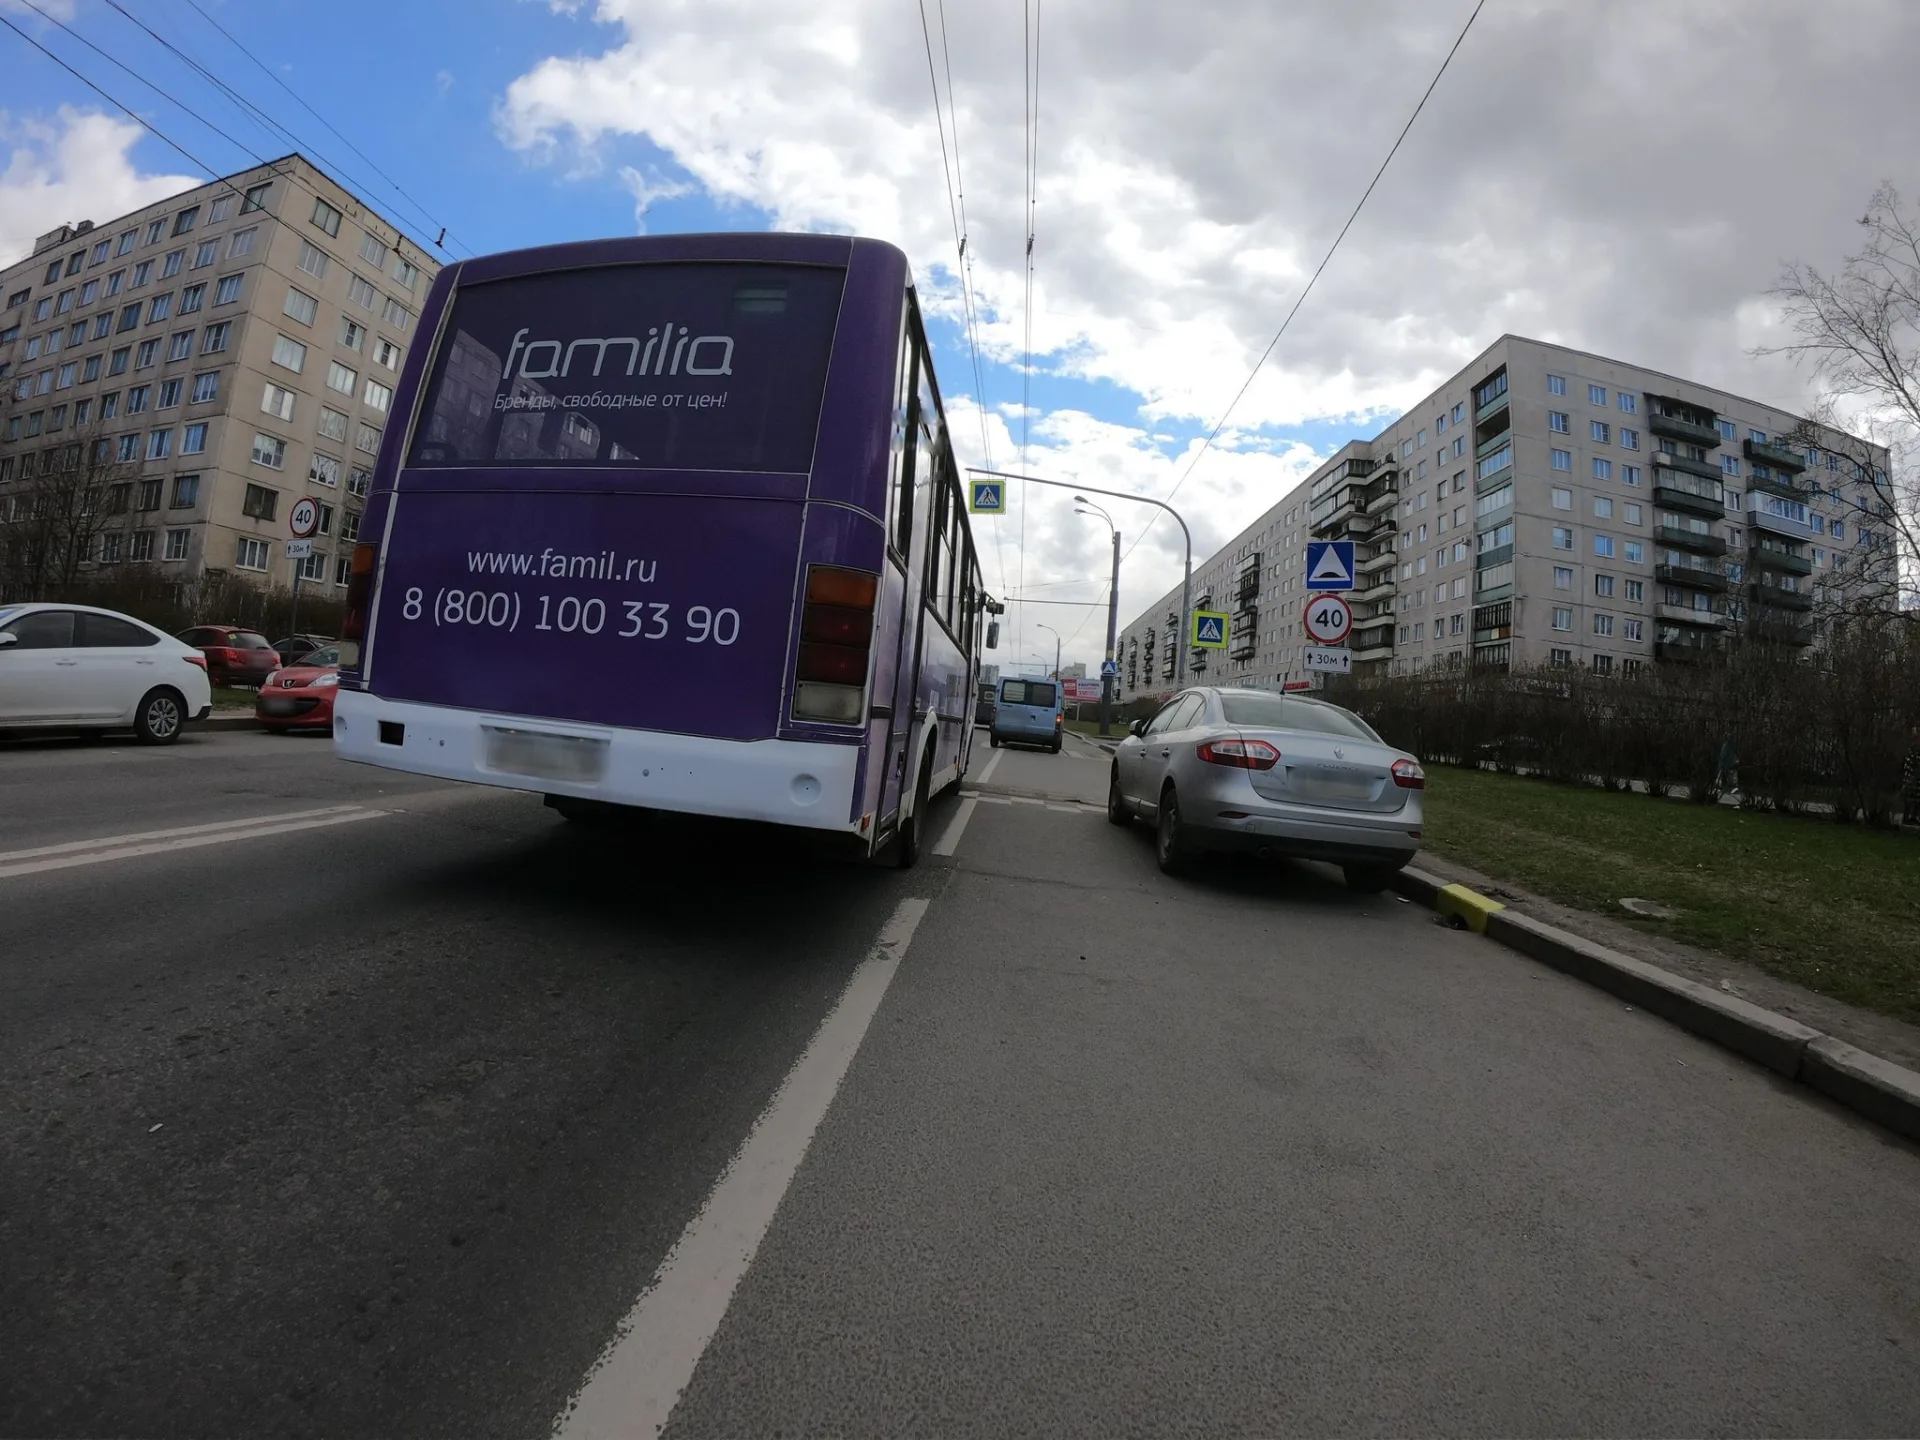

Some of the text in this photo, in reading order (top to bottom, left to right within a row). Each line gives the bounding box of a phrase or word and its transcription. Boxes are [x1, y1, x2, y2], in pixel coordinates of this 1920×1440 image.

[502, 323, 734, 379] familia
[494, 391, 728, 412] Бренды, свободные от цен!
[295, 509, 311, 524] 40
[467, 548, 657, 583] www.famil.ru
[402, 587, 740, 645] 8 (800) 100 33 90
[1315, 609, 1343, 628] 40
[1316, 654, 1338, 665] 30м
